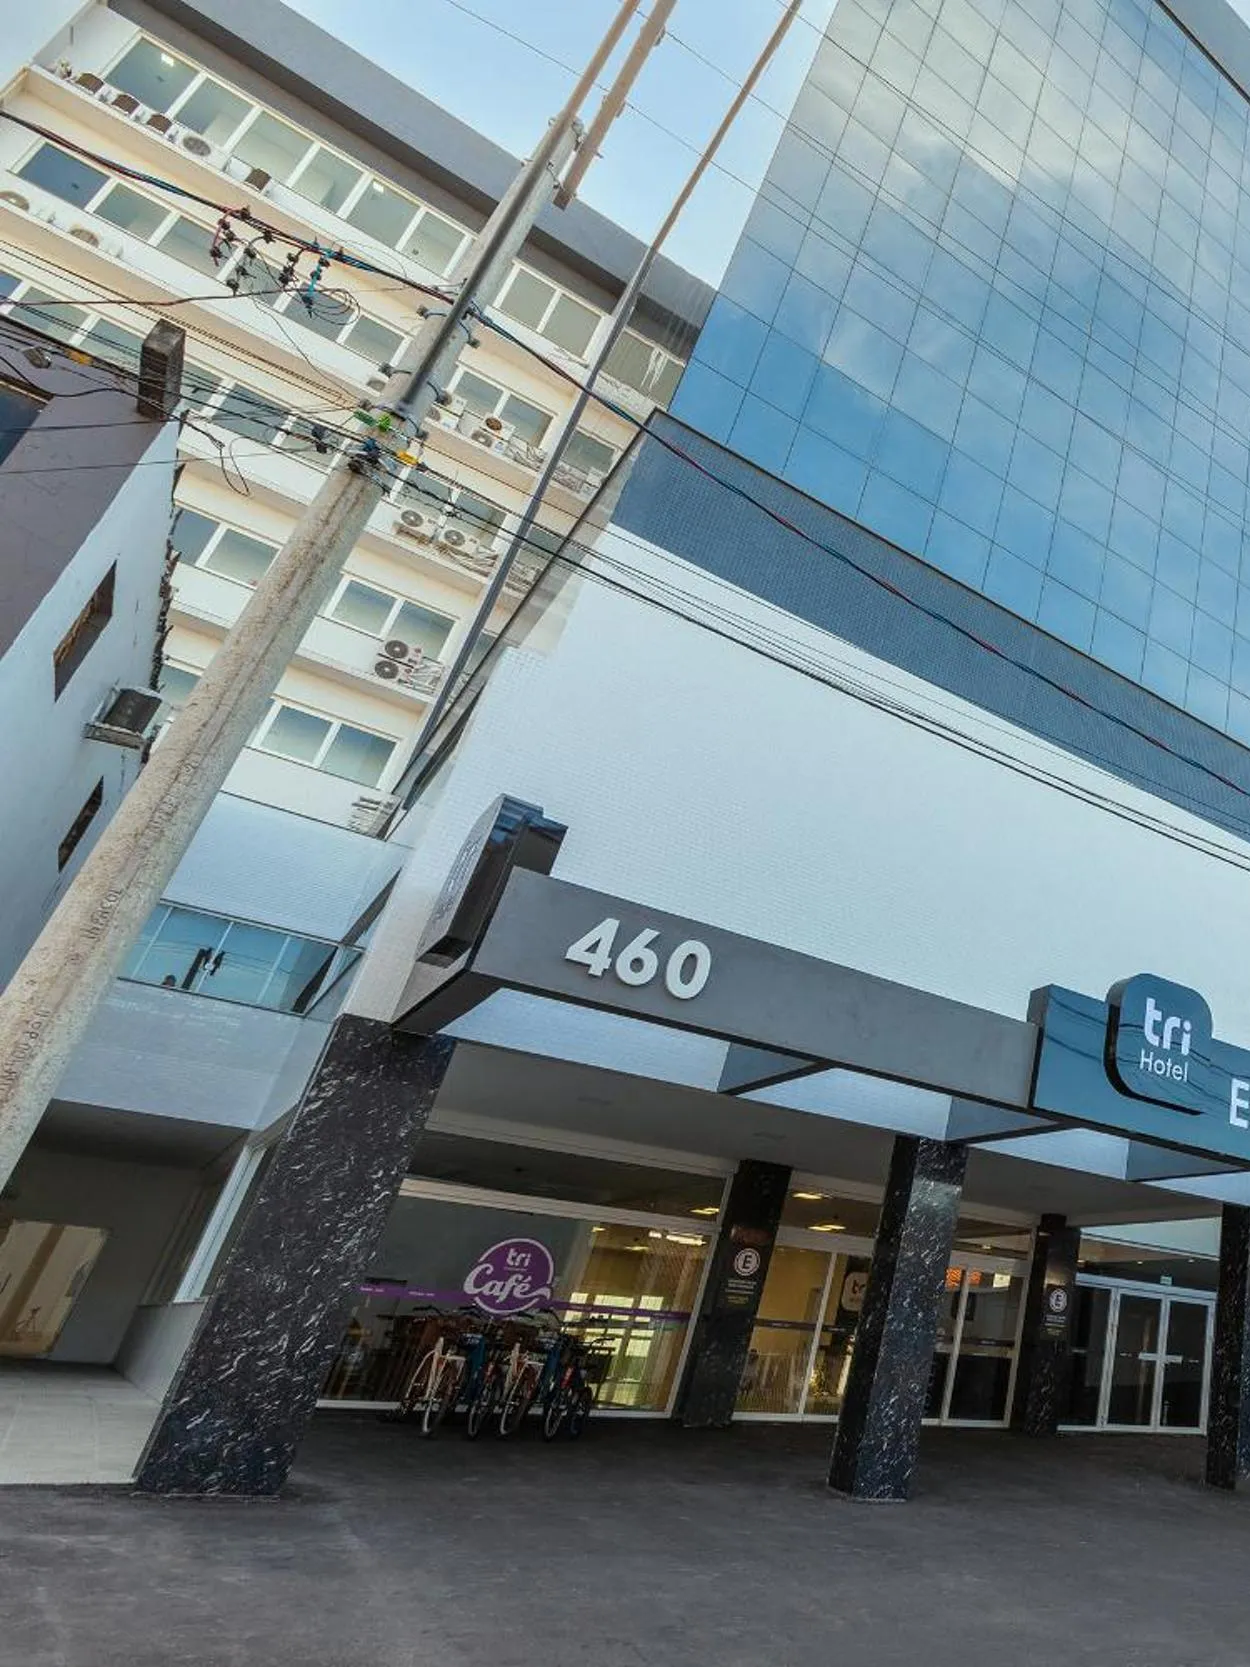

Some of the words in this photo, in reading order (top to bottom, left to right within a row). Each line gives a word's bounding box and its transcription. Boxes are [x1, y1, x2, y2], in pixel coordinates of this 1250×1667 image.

[564, 917, 712, 1000] 460
[1144, 997, 1192, 1056] tri
[1139, 1047, 1189, 1083] Hotel
[506, 1247, 532, 1267] tri
[463, 1263, 552, 1303] Café
